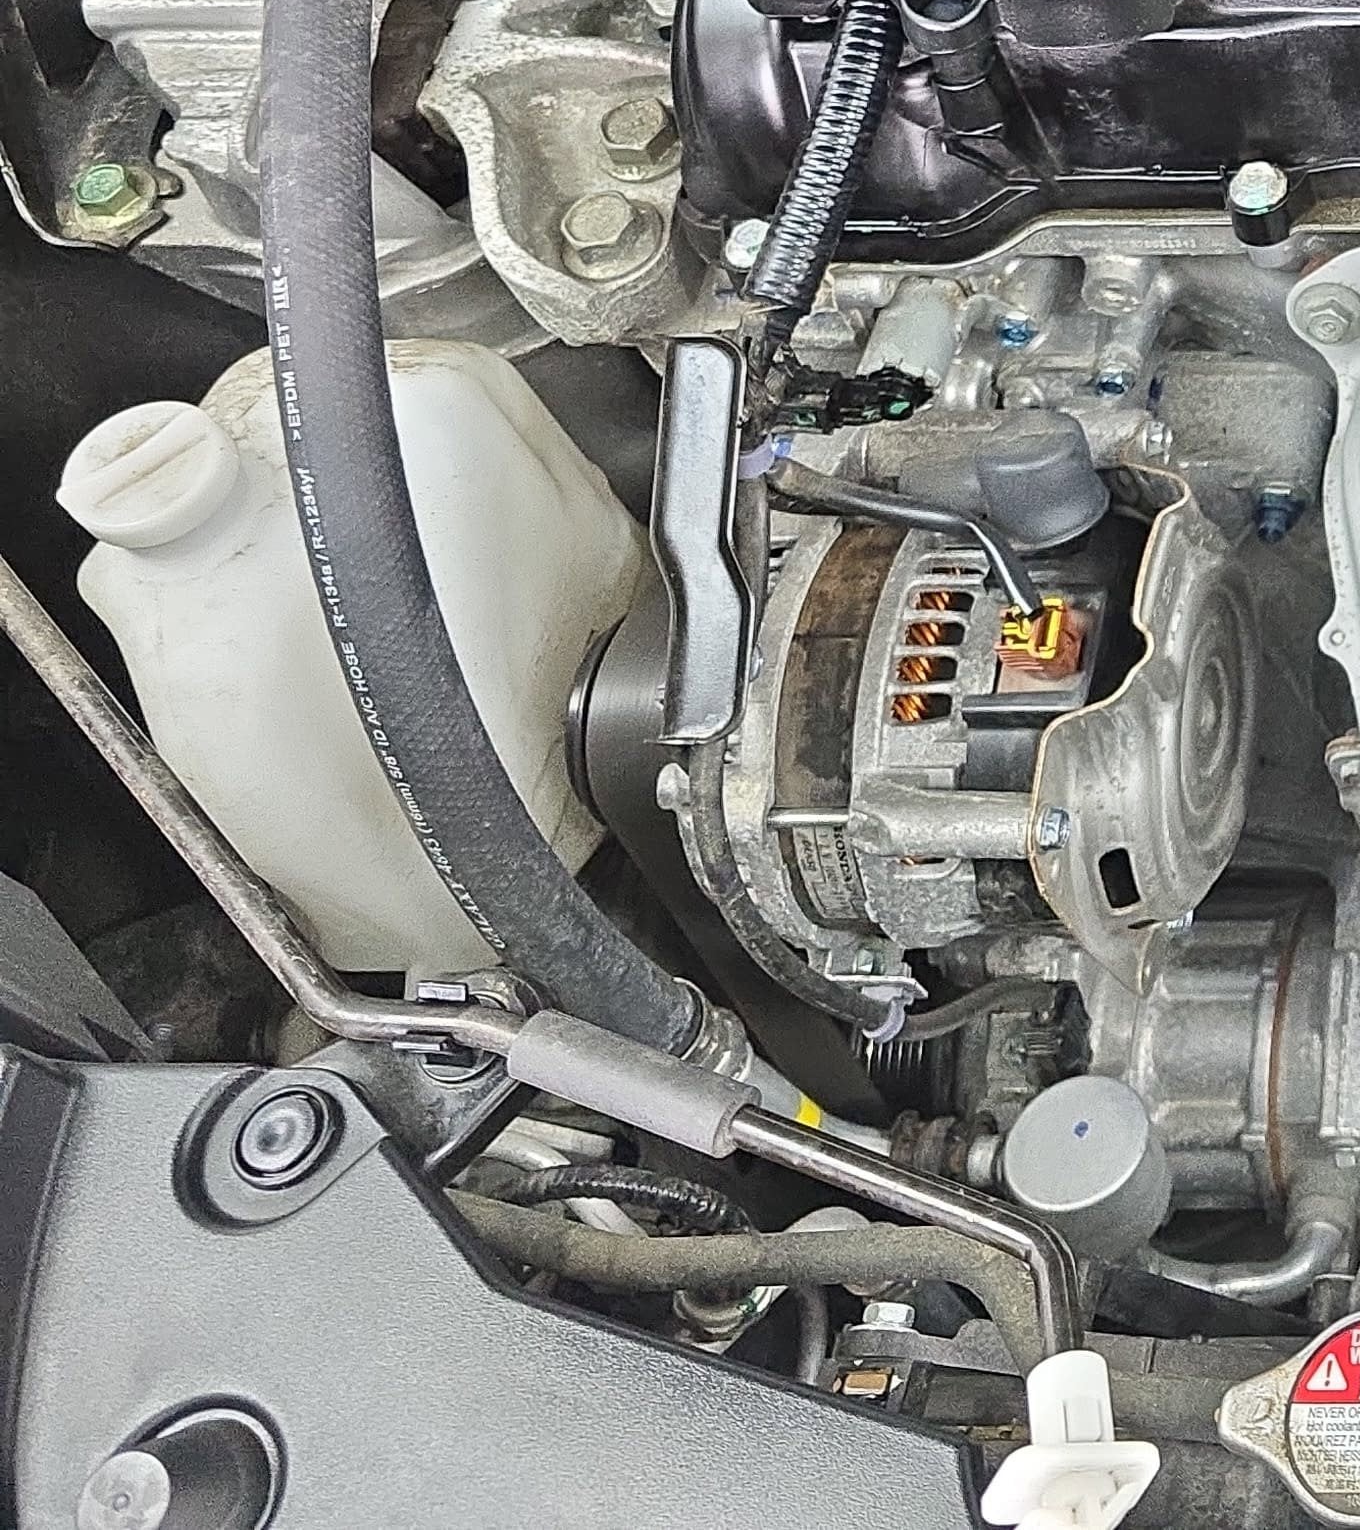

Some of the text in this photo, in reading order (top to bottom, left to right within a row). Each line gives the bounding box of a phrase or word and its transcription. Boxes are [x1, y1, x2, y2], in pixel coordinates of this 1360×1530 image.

[275, 322, 293, 362] PET
[341, 641, 369, 693] HOSE
[359, 696, 382, 727] A/C
[372, 729, 390, 748] ID
[1307, 1407, 1346, 1419] NEVER
